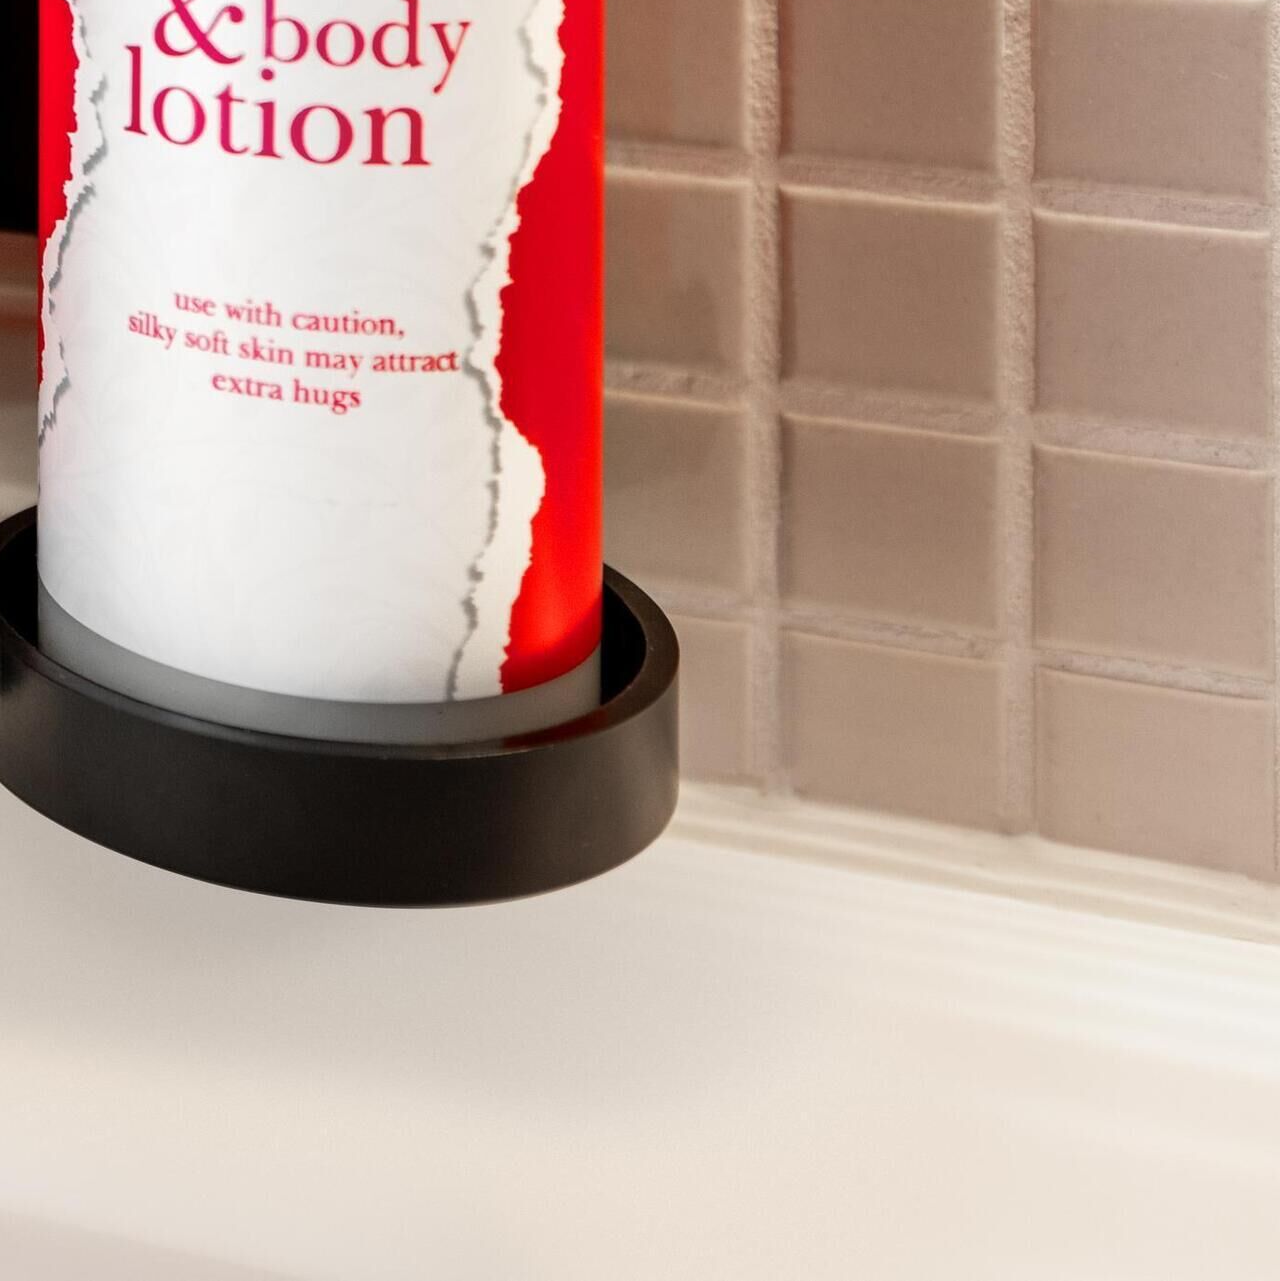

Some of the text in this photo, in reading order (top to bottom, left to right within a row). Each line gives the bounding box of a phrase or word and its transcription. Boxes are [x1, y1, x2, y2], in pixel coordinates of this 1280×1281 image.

[124, 45, 432, 167] lotion
[173, 291, 405, 338] use with caution,
[128, 311, 460, 379] silky soft skin may attract
[211, 372, 362, 415] extra hugs
